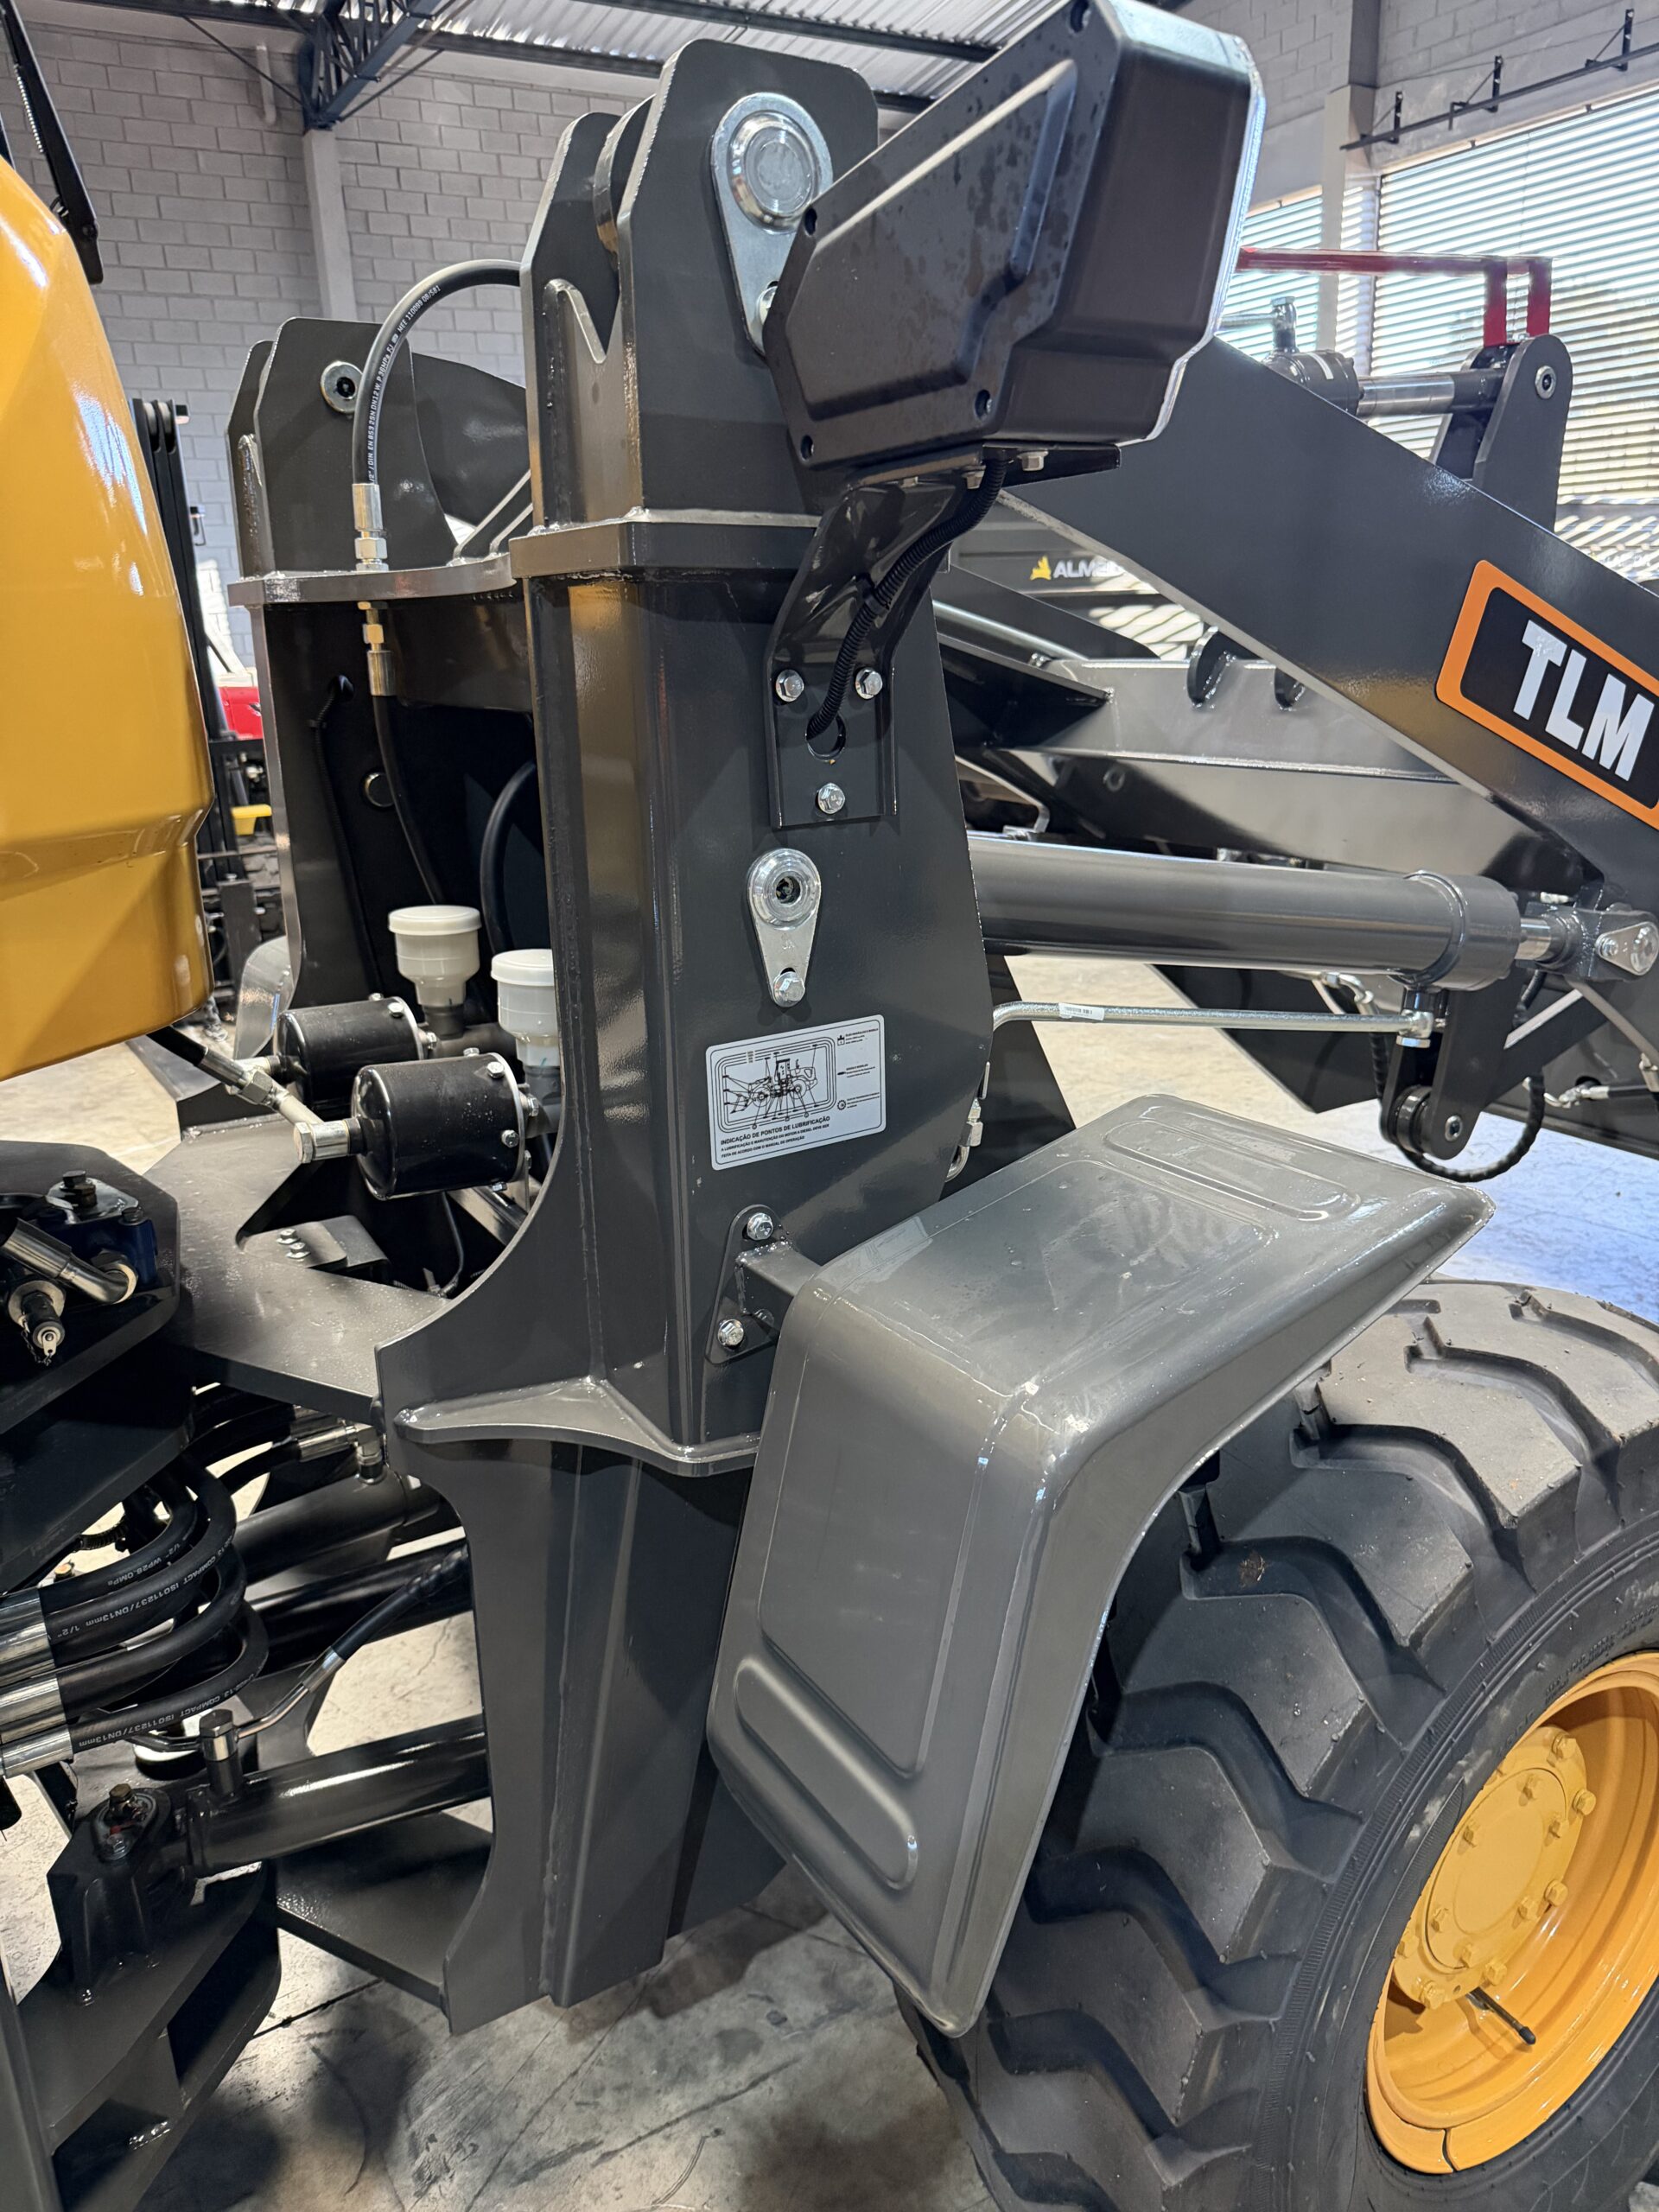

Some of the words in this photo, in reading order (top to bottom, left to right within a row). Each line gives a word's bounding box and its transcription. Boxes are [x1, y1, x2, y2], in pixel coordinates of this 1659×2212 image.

[370, 391, 379, 410] DN12
[367, 441, 374, 450] EN
[1513, 619, 1655, 782] TLM
[721, 1134, 751, 1145] INDICAÇÃO
[760, 1127, 782, 1136] PONTOS
[791, 1116, 830, 1129] LUBRIFICAÇÃO
[183, 1555, 216, 1585] COMPACT
[86, 1582, 180, 1626] ISO11237/DN13mm
[57, 1625, 80, 1637] 1/2"
[179, 1694, 220, 1718] COMPACT
[79, 1713, 175, 1747] ISO11237/DN13mm
